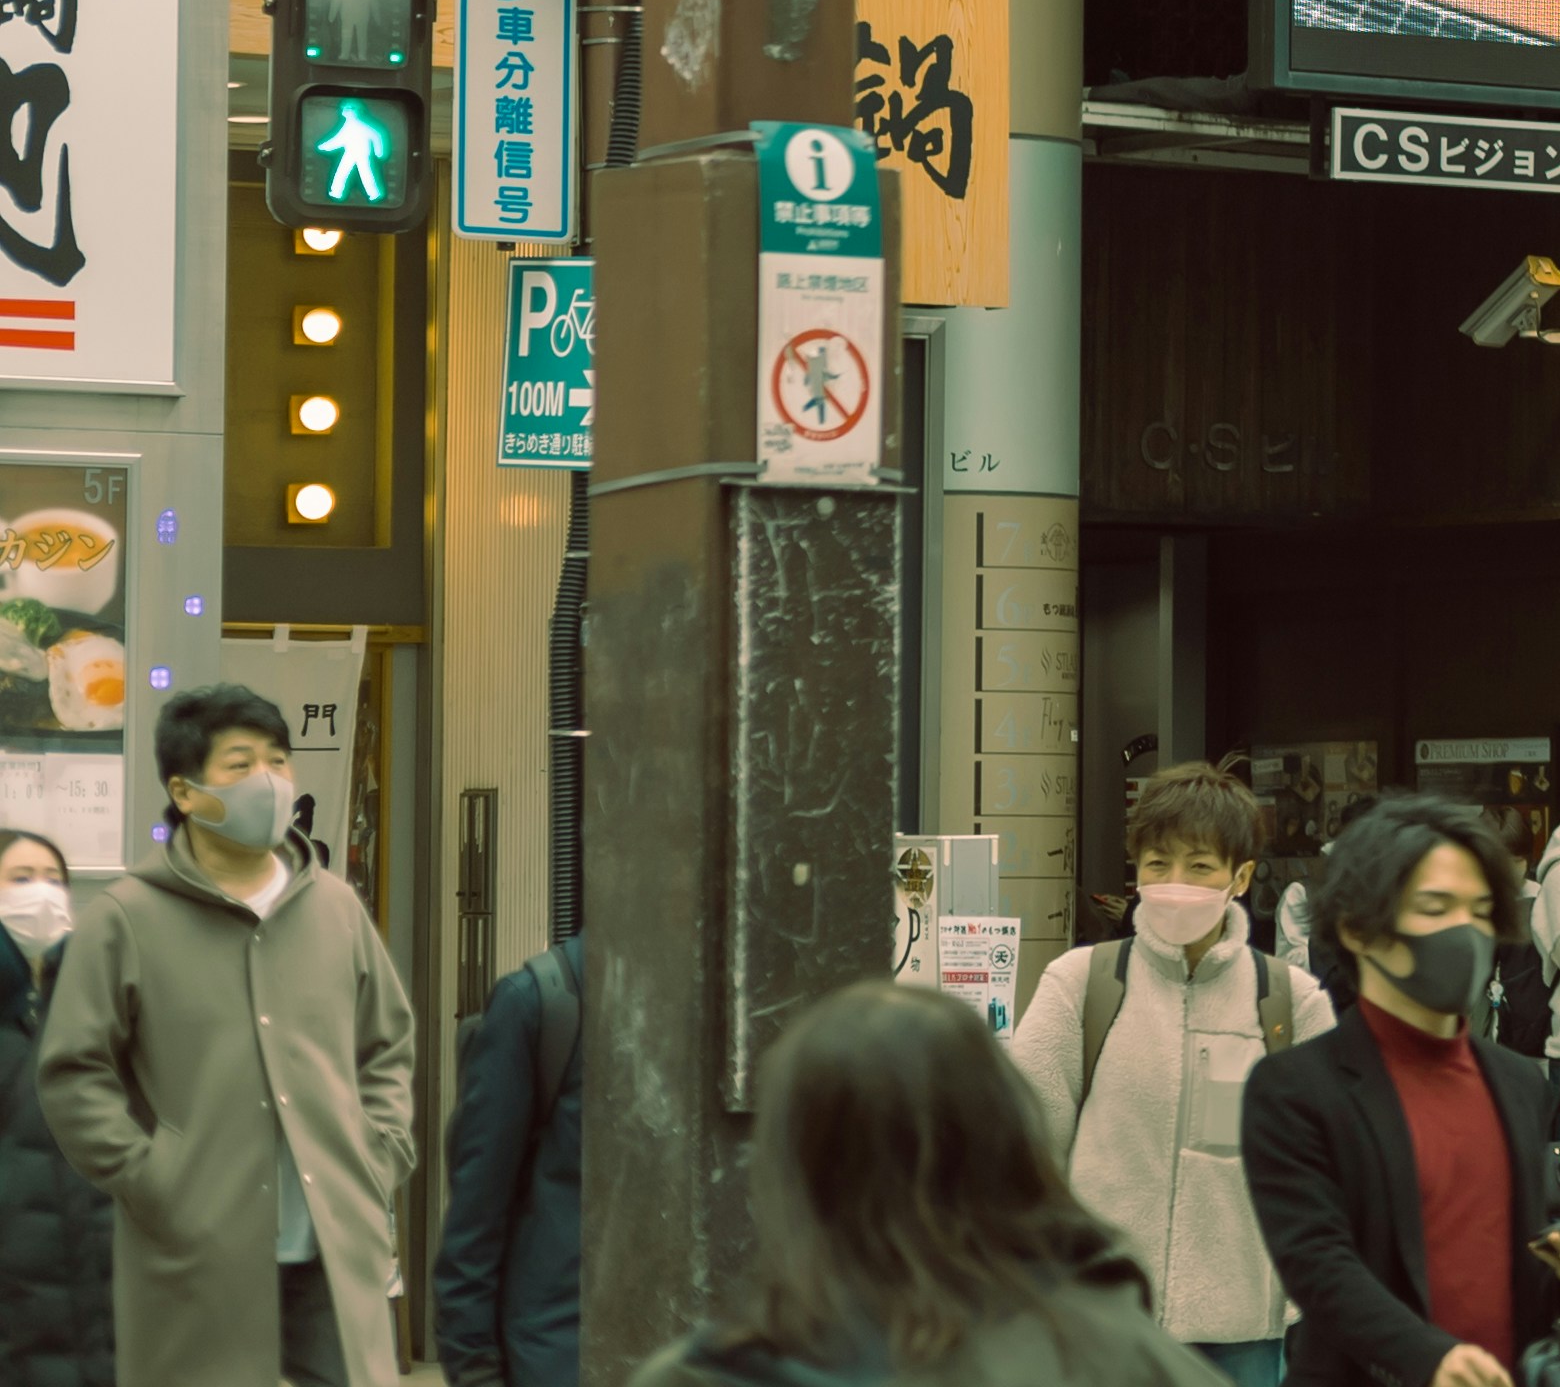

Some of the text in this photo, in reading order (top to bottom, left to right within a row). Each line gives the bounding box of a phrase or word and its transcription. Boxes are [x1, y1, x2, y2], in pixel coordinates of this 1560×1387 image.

[518, 270, 557, 357] P
[509, 380, 565, 417] 100M
[949, 448, 1001, 473] ビル
[84, 467, 124, 506] 5F
